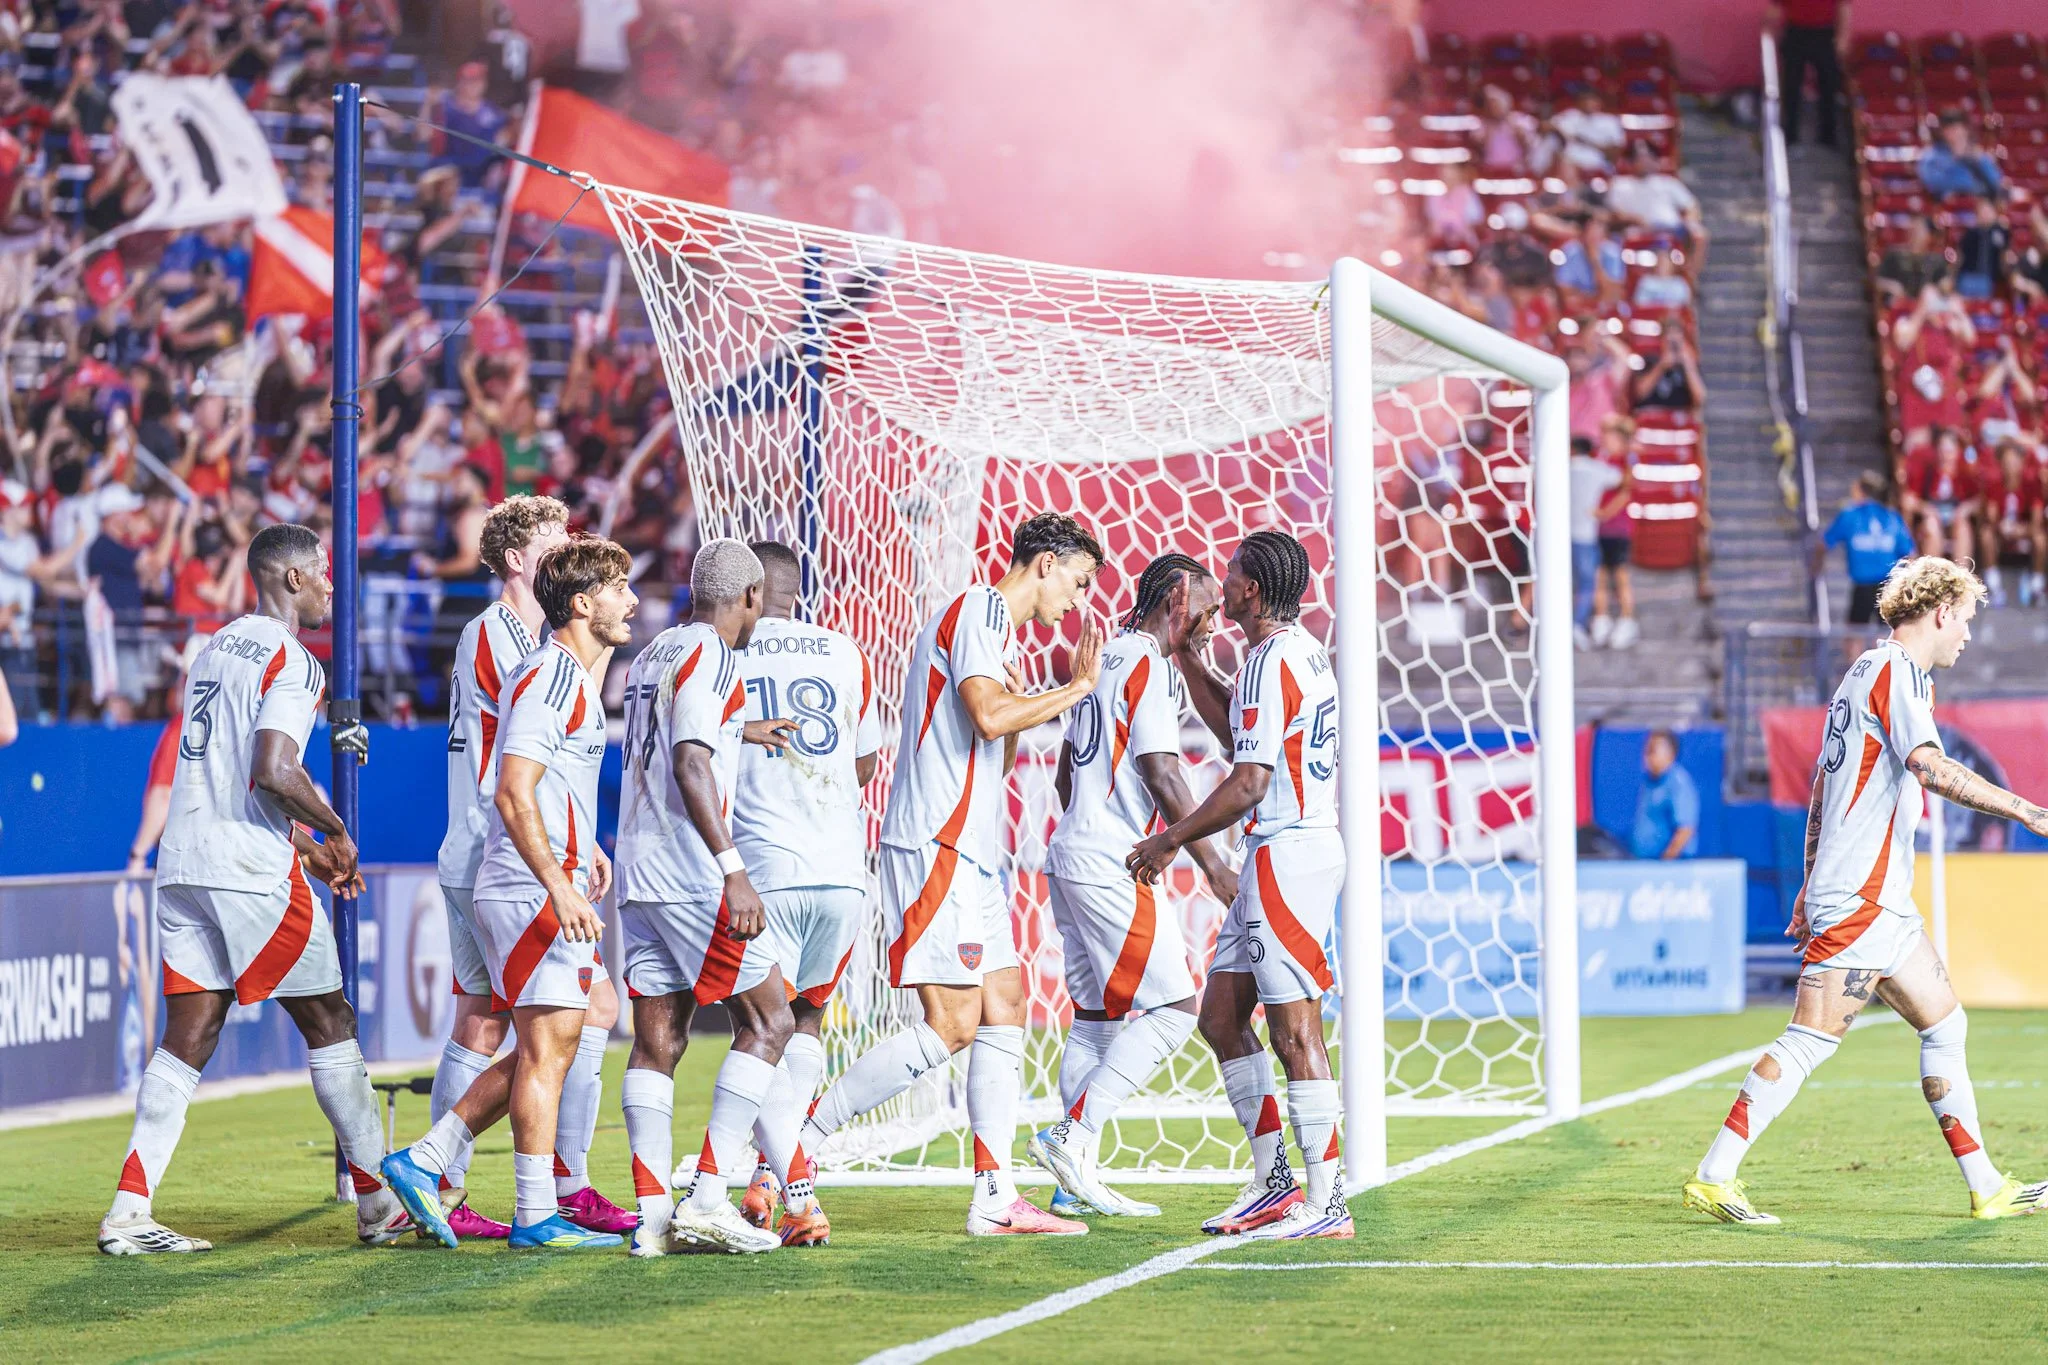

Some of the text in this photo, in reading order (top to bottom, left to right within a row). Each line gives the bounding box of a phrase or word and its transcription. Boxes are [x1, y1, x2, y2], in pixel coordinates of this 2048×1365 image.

[744, 636, 831, 658] MOORE
[180, 681, 221, 761] 3
[623, 684, 659, 770] 77
[746, 676, 839, 758] 18
[1072, 692, 1102, 768] 0
[1307, 695, 1338, 782] 5
[1824, 696, 1851, 774] 8
